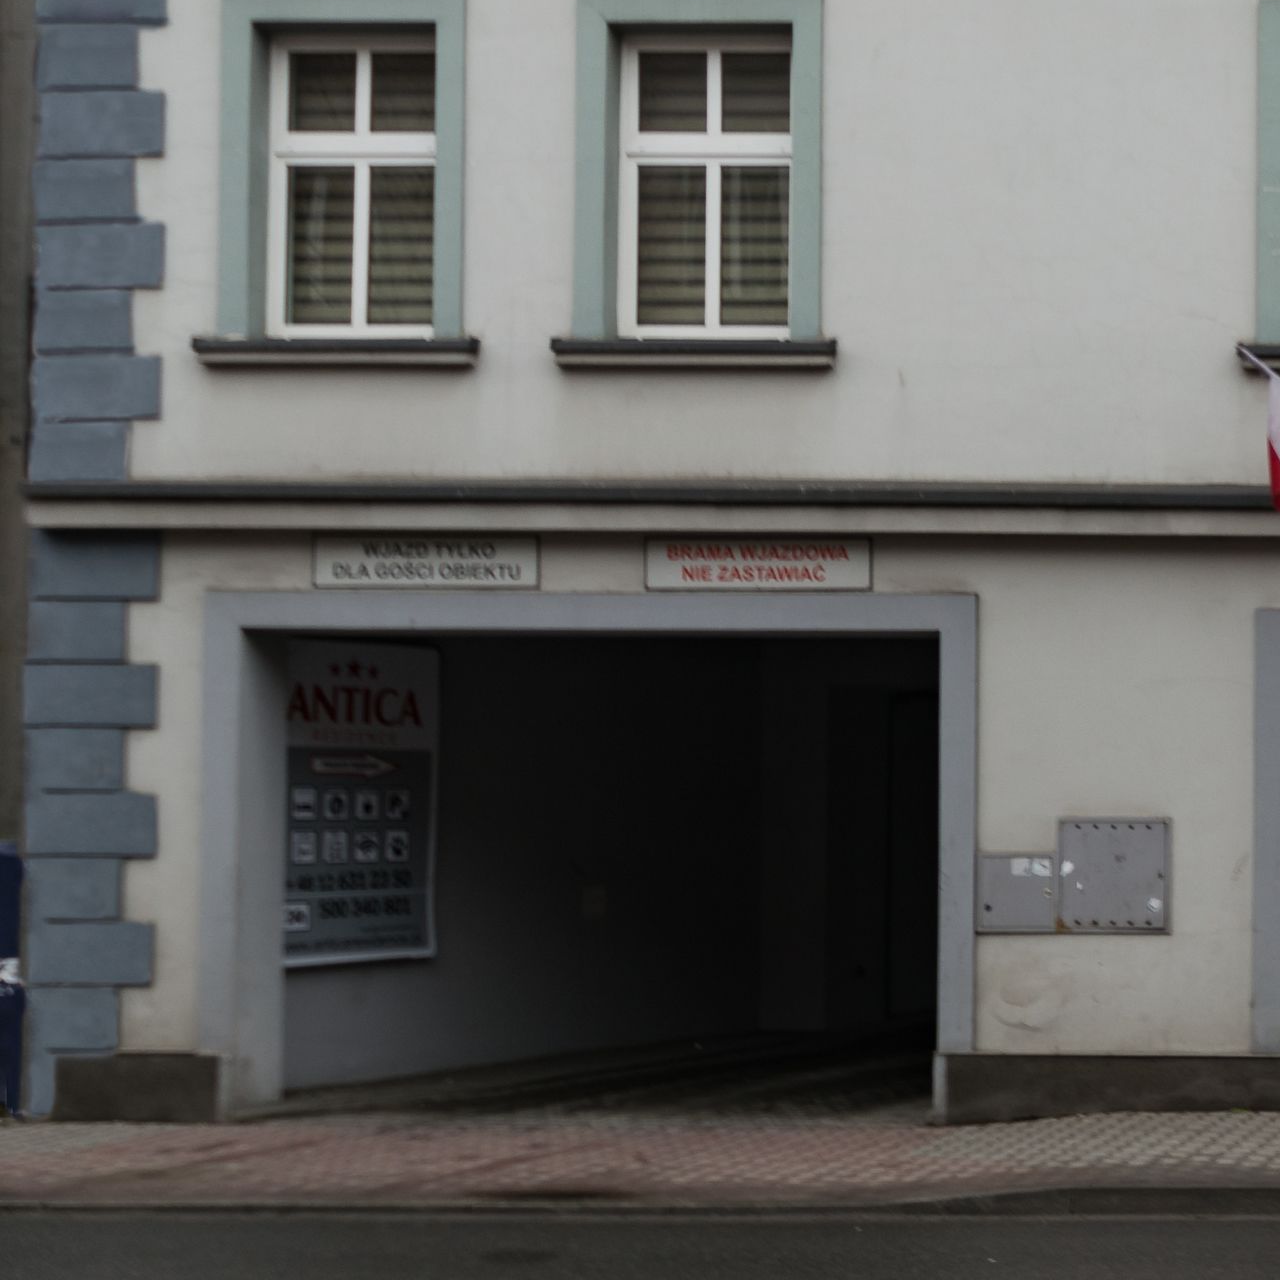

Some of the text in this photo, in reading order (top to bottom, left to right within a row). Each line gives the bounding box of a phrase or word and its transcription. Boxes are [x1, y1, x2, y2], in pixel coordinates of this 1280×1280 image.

[361, 541, 497, 559] WJAZD TYLKO
[666, 543, 850, 562] BRAMA WJAZDOWA
[331, 559, 522, 581] DLA GOŚCI OBIEKTU
[681, 562, 827, 583] NIE ZASTAWIAĆ
[287, 682, 424, 728] ANTICA
